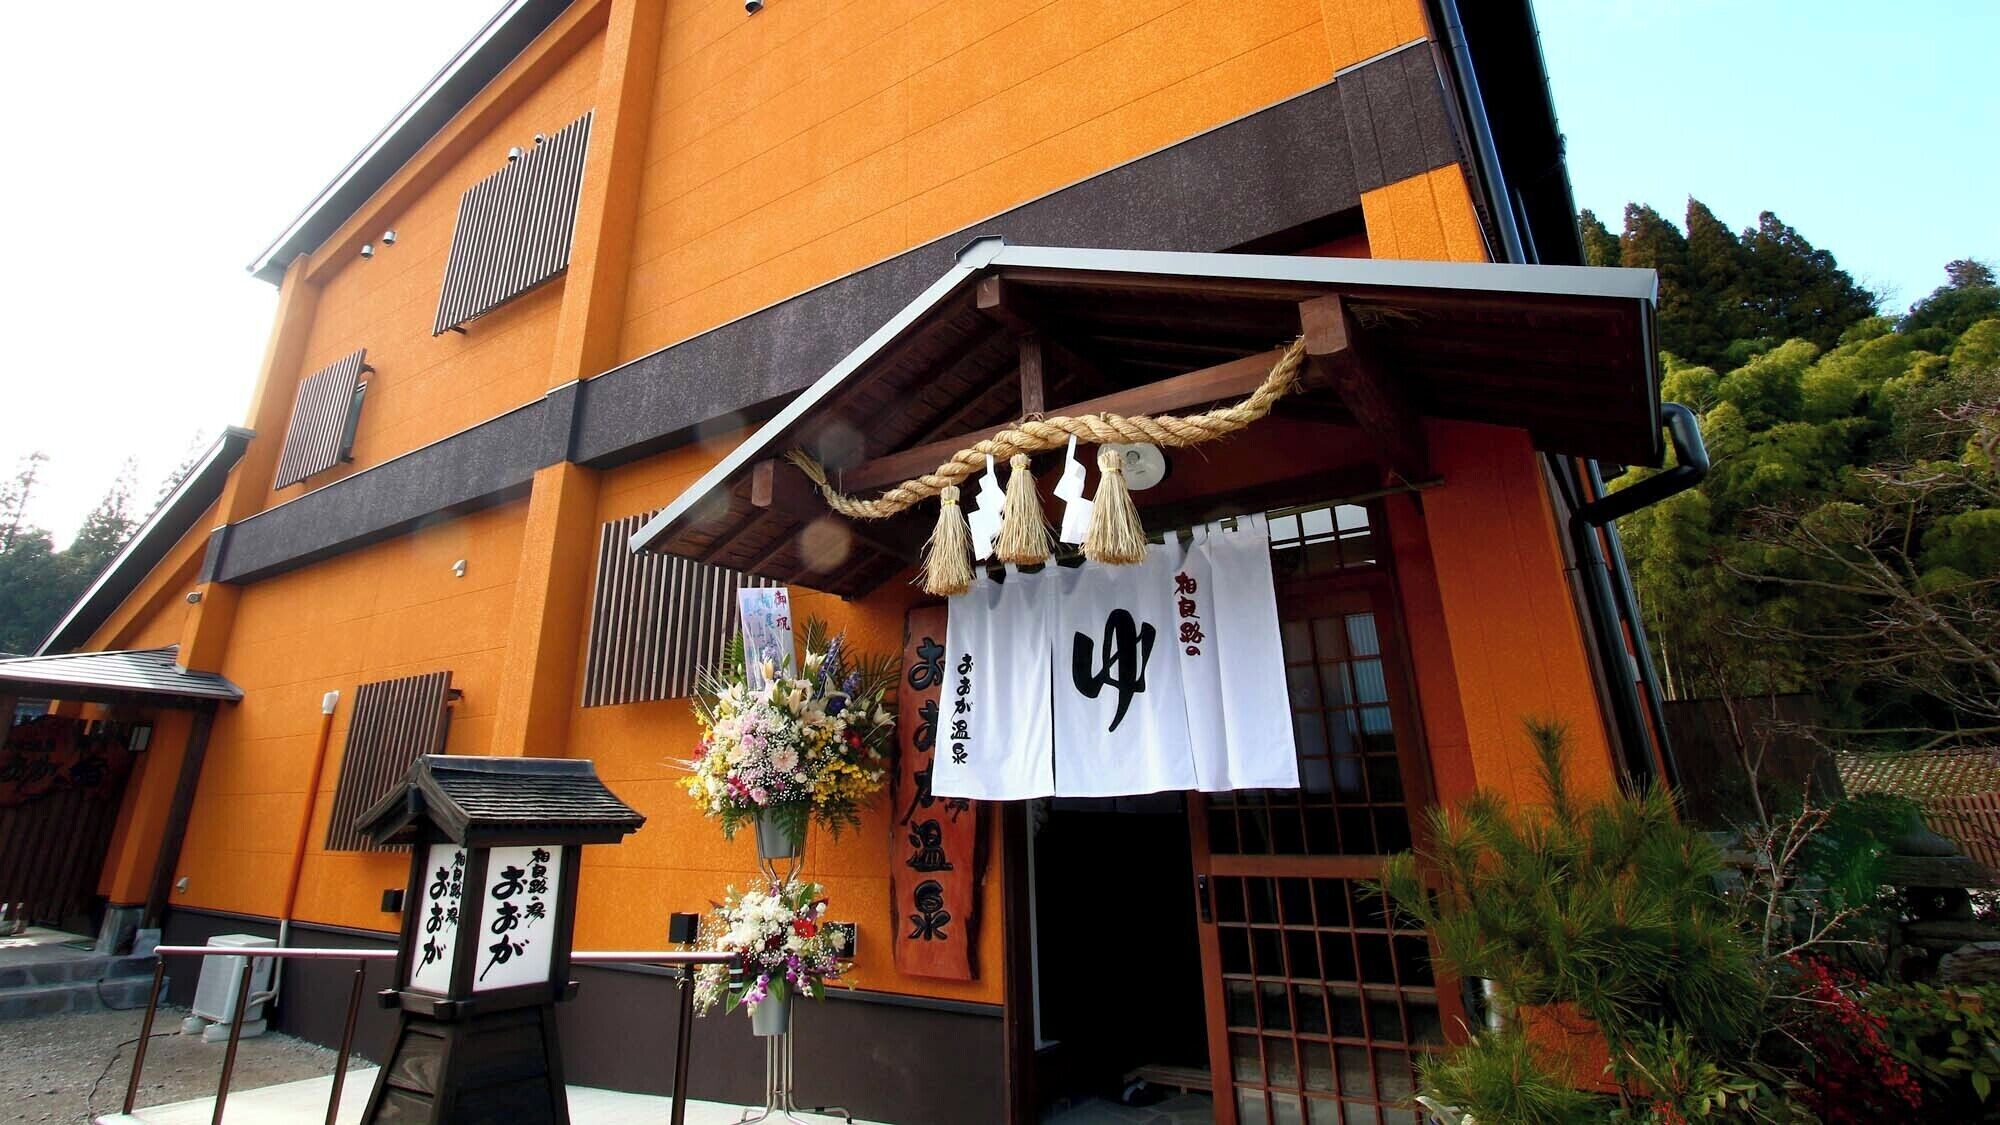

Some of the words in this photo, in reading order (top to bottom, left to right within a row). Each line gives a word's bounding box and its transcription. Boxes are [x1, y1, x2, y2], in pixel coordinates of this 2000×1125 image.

[1174, 571, 1205, 656] 相良路の
[951, 653, 975, 765] おおが温泉
[1072, 608, 1156, 732] ゆ
[416, 866, 451, 978] おおが
[479, 865, 530, 982] おおが
